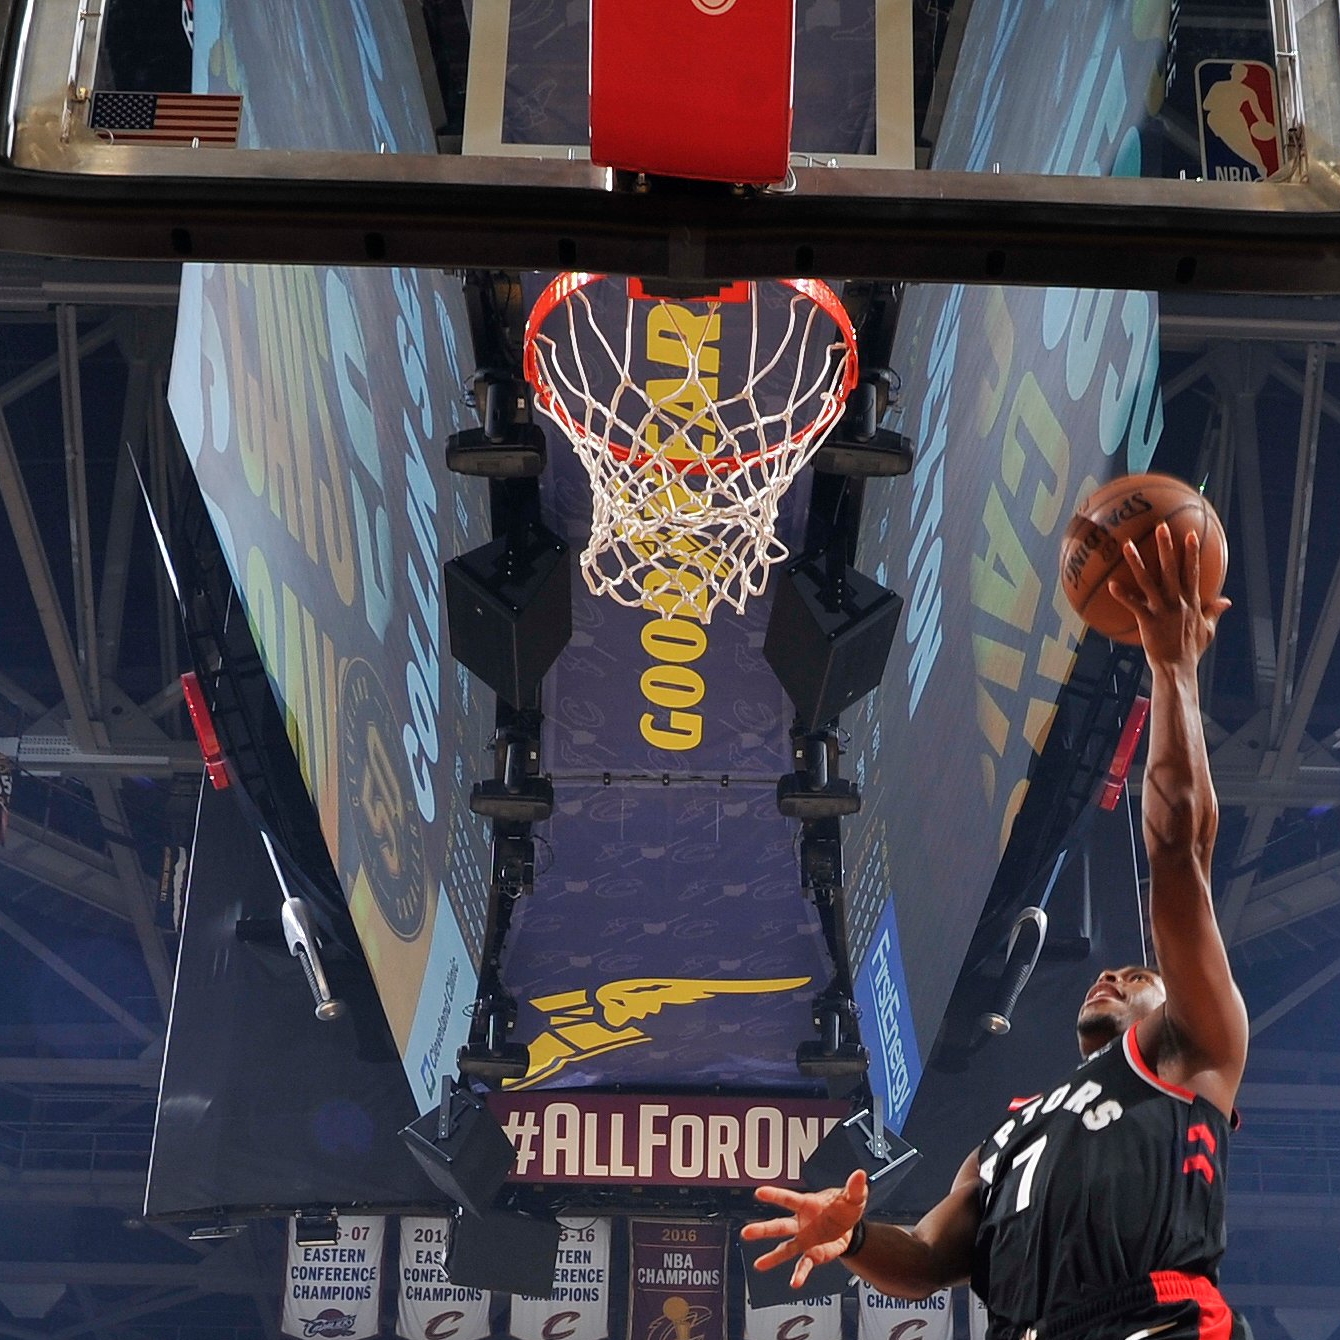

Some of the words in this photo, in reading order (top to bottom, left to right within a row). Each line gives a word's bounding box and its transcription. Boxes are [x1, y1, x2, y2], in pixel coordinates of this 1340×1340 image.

[1215, 166, 1253, 182] NBA
[979, 1080, 1123, 1186] APTORS
[1012, 1134, 1047, 1212] 7
[662, 1229, 697, 1242] 2016
[303, 1248, 365, 1264] EASTERN
[663, 1253, 693, 1269] NBA
[291, 1266, 376, 1282] CONFERENCE
[637, 1268, 720, 1286] CHAMPIONS
[293, 1285, 371, 1301] CHAMPIONS
[406, 1287, 483, 1302] CHAMPIONS
